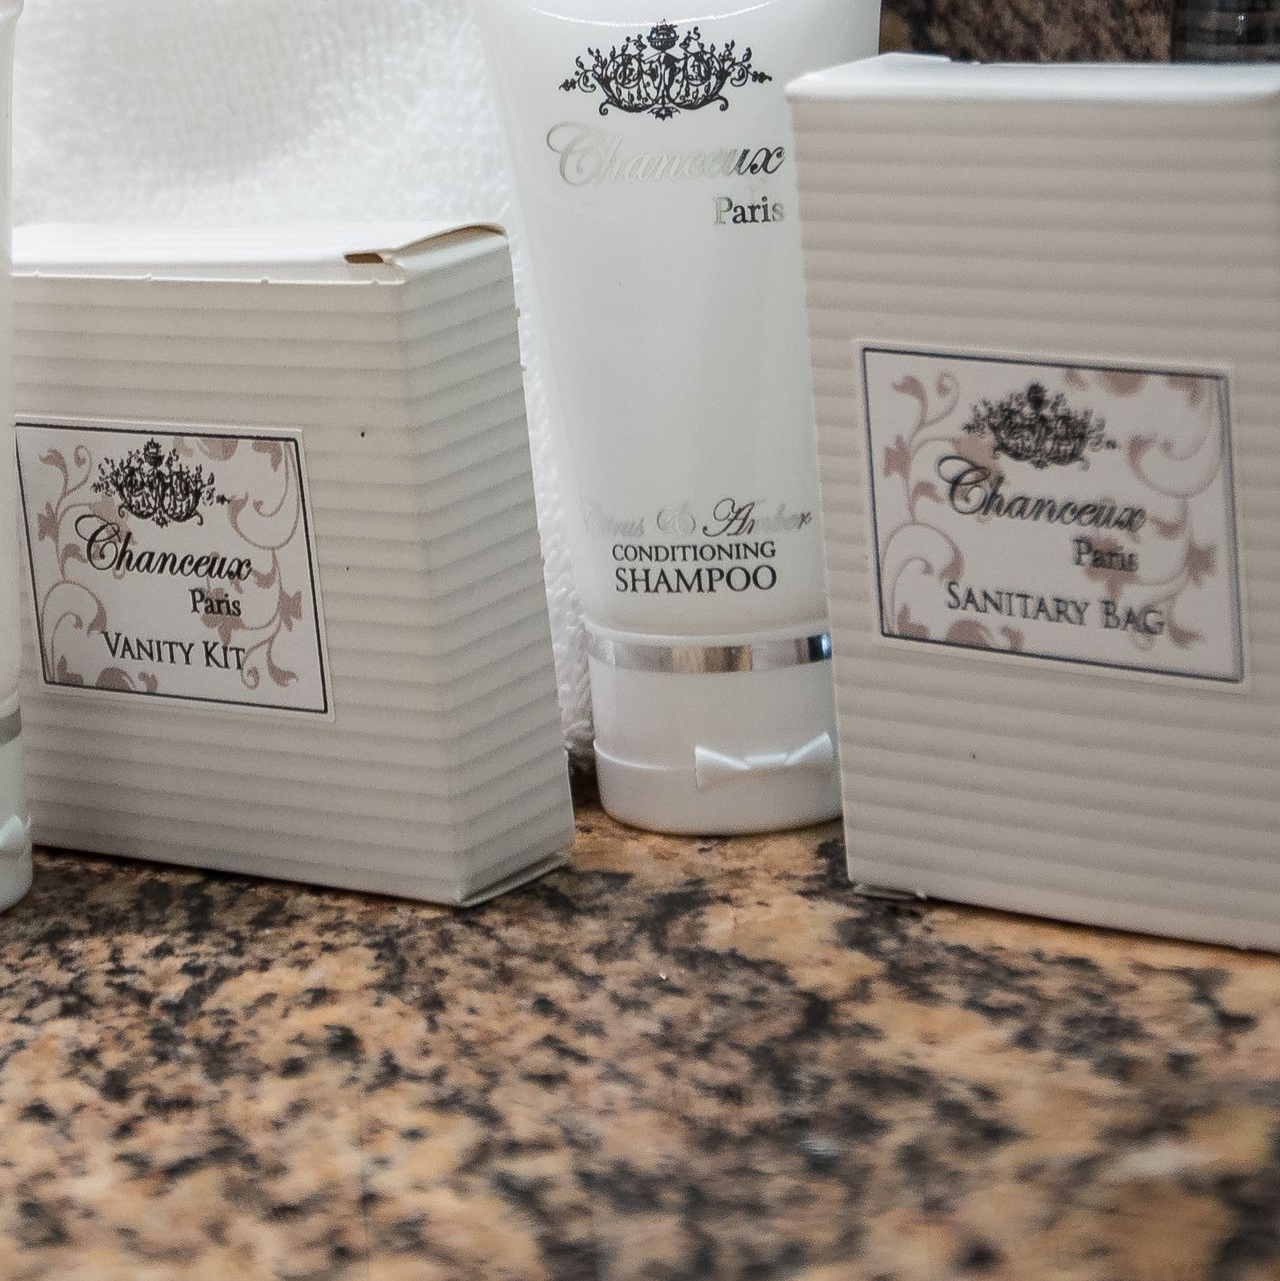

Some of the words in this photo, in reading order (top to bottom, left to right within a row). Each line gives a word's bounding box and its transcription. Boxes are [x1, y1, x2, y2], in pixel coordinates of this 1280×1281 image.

[713, 195, 785, 226] Paris
[937, 455, 1147, 534] Chanceux
[74, 514, 252, 581] Chanceux
[612, 541, 776, 563] CONDITIONING
[1071, 537, 1139, 574] Paris
[615, 565, 777, 594] SHAMPOO
[189, 588, 242, 617] Paris
[946, 581, 1092, 626] SANITARY
[1101, 599, 1166, 635] BAG
[100, 630, 194, 666] VANITY
[201, 640, 246, 671] KIT
